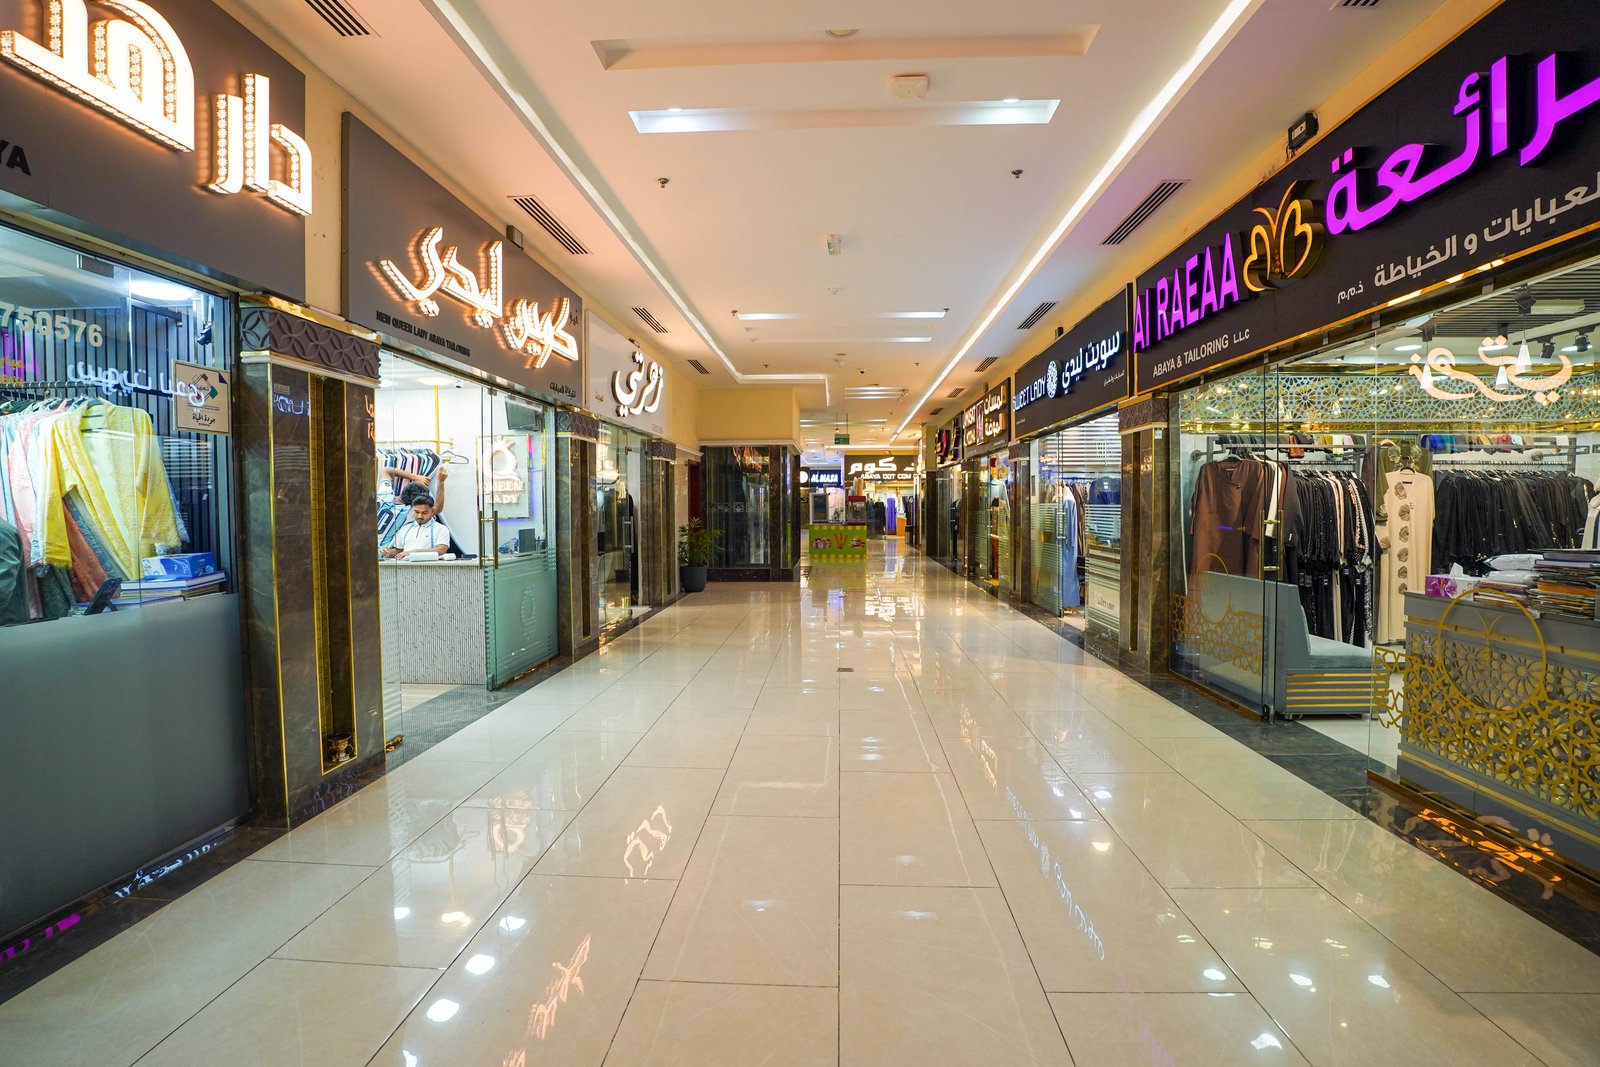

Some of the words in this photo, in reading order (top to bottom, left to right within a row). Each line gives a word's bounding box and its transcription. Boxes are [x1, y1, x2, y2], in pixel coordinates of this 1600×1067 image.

[208, 73, 312, 216] دار
[1326, 52, 1600, 236] رائعة
[1374, 234, 1457, 287] الخياطة
[1464, 233, 1478, 255] و
[379, 226, 503, 328] ليدي
[1156, 232, 1240, 341] RAEAA
[376, 310, 391, 325] NEW
[391, 317, 412, 334] QUEEN
[413, 325, 428, 340] LADY
[429, 332, 446, 347] ABAYA
[446, 338, 471, 357] TAILORING
[1085, 330, 1121, 372] سويت
[1153, 358, 1176, 378] ABAYA
[1176, 355, 1183, 368] &
[1184, 335, 1229, 365] TAILORING
[612, 351, 664, 417] زهرتي
[1030, 375, 1046, 401] LADY
[1062, 347, 1083, 394] ليدي
